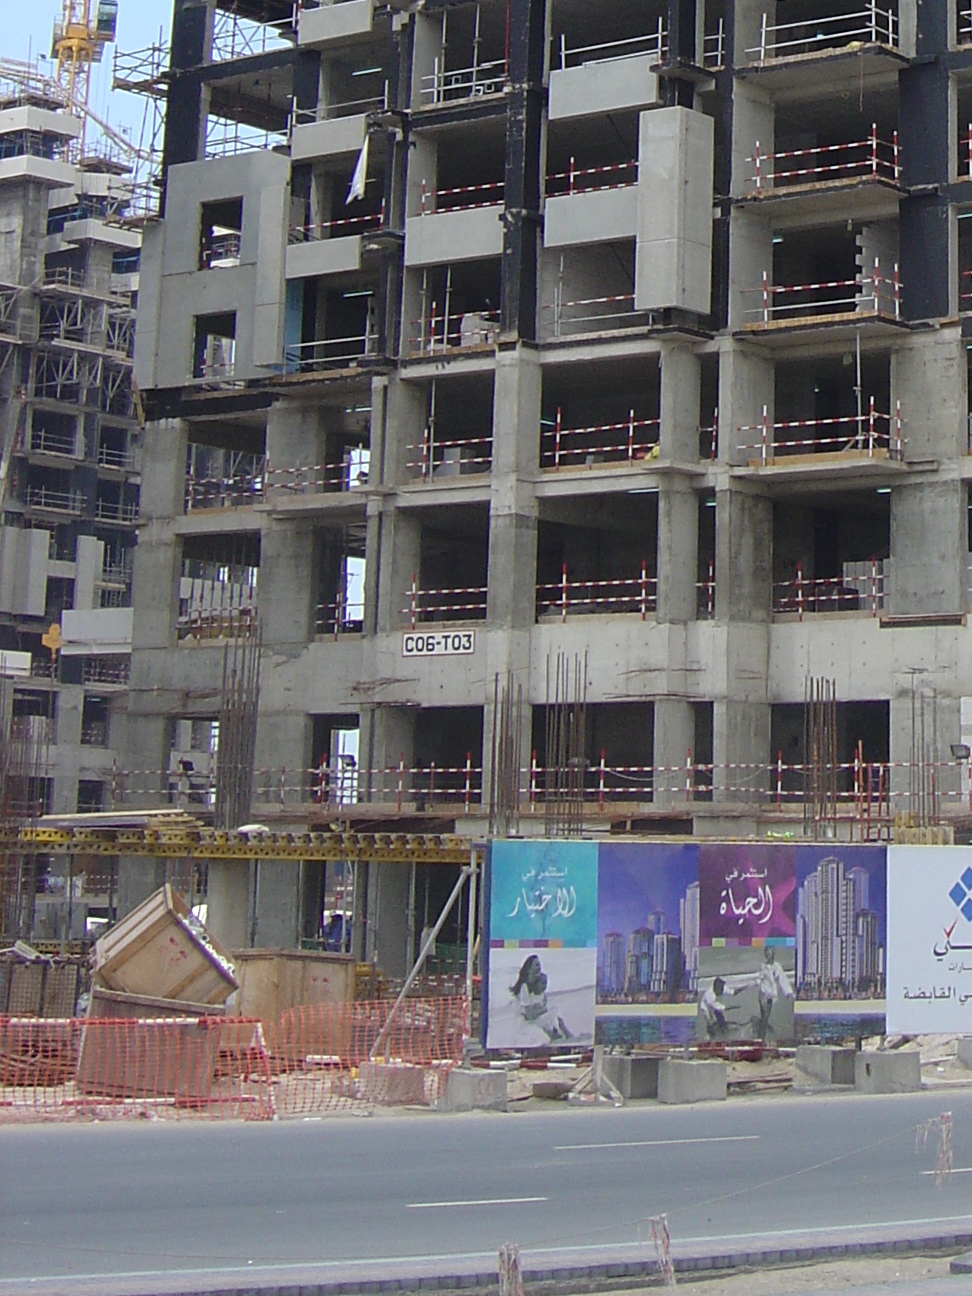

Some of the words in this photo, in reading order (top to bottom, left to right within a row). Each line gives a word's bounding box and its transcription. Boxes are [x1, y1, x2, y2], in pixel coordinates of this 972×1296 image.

[521, 867, 536, 882] في
[725, 868, 738, 883] في
[740, 867, 768, 880] استثمر
[506, 885, 577, 918] الاختيار
[719, 884, 773, 925] الحياة
[903, 986, 956, 1003] القابضة
